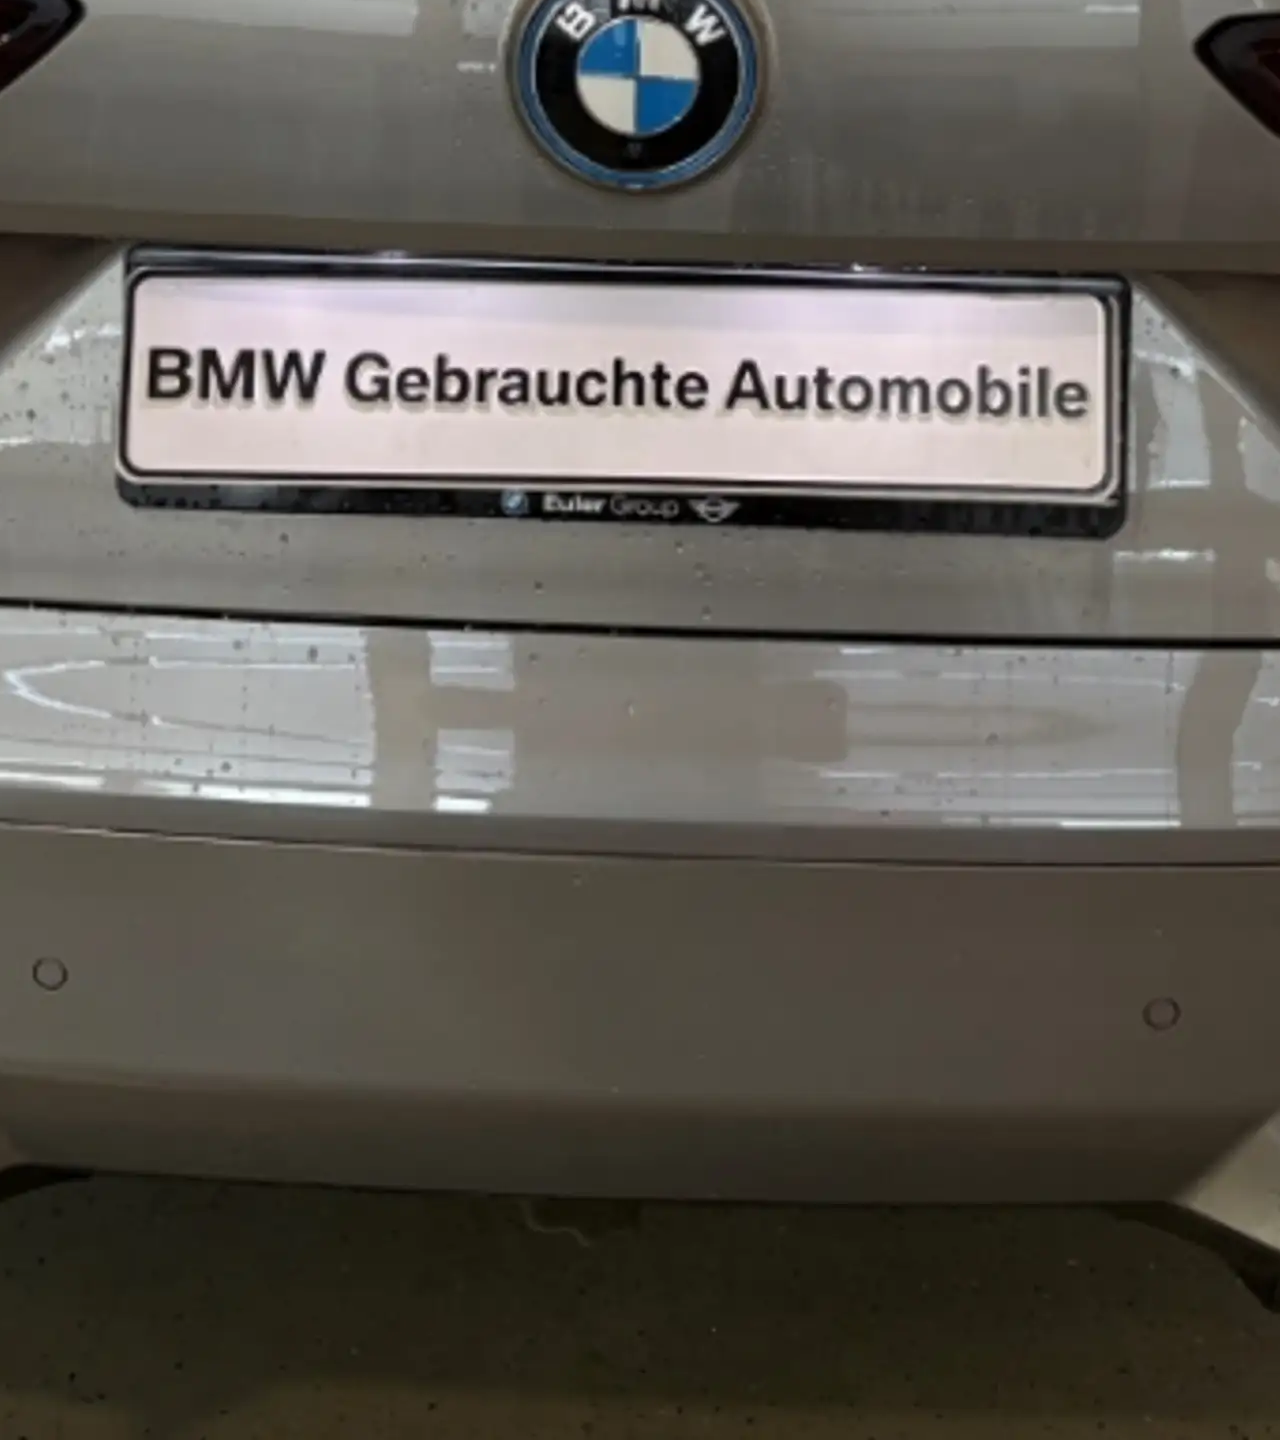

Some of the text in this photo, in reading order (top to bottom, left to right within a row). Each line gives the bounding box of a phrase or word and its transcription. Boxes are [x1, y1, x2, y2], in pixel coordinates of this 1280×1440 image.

[147, 346, 1089, 419] BMW Gebrauchte Automobile
[609, 493, 680, 519] Group
